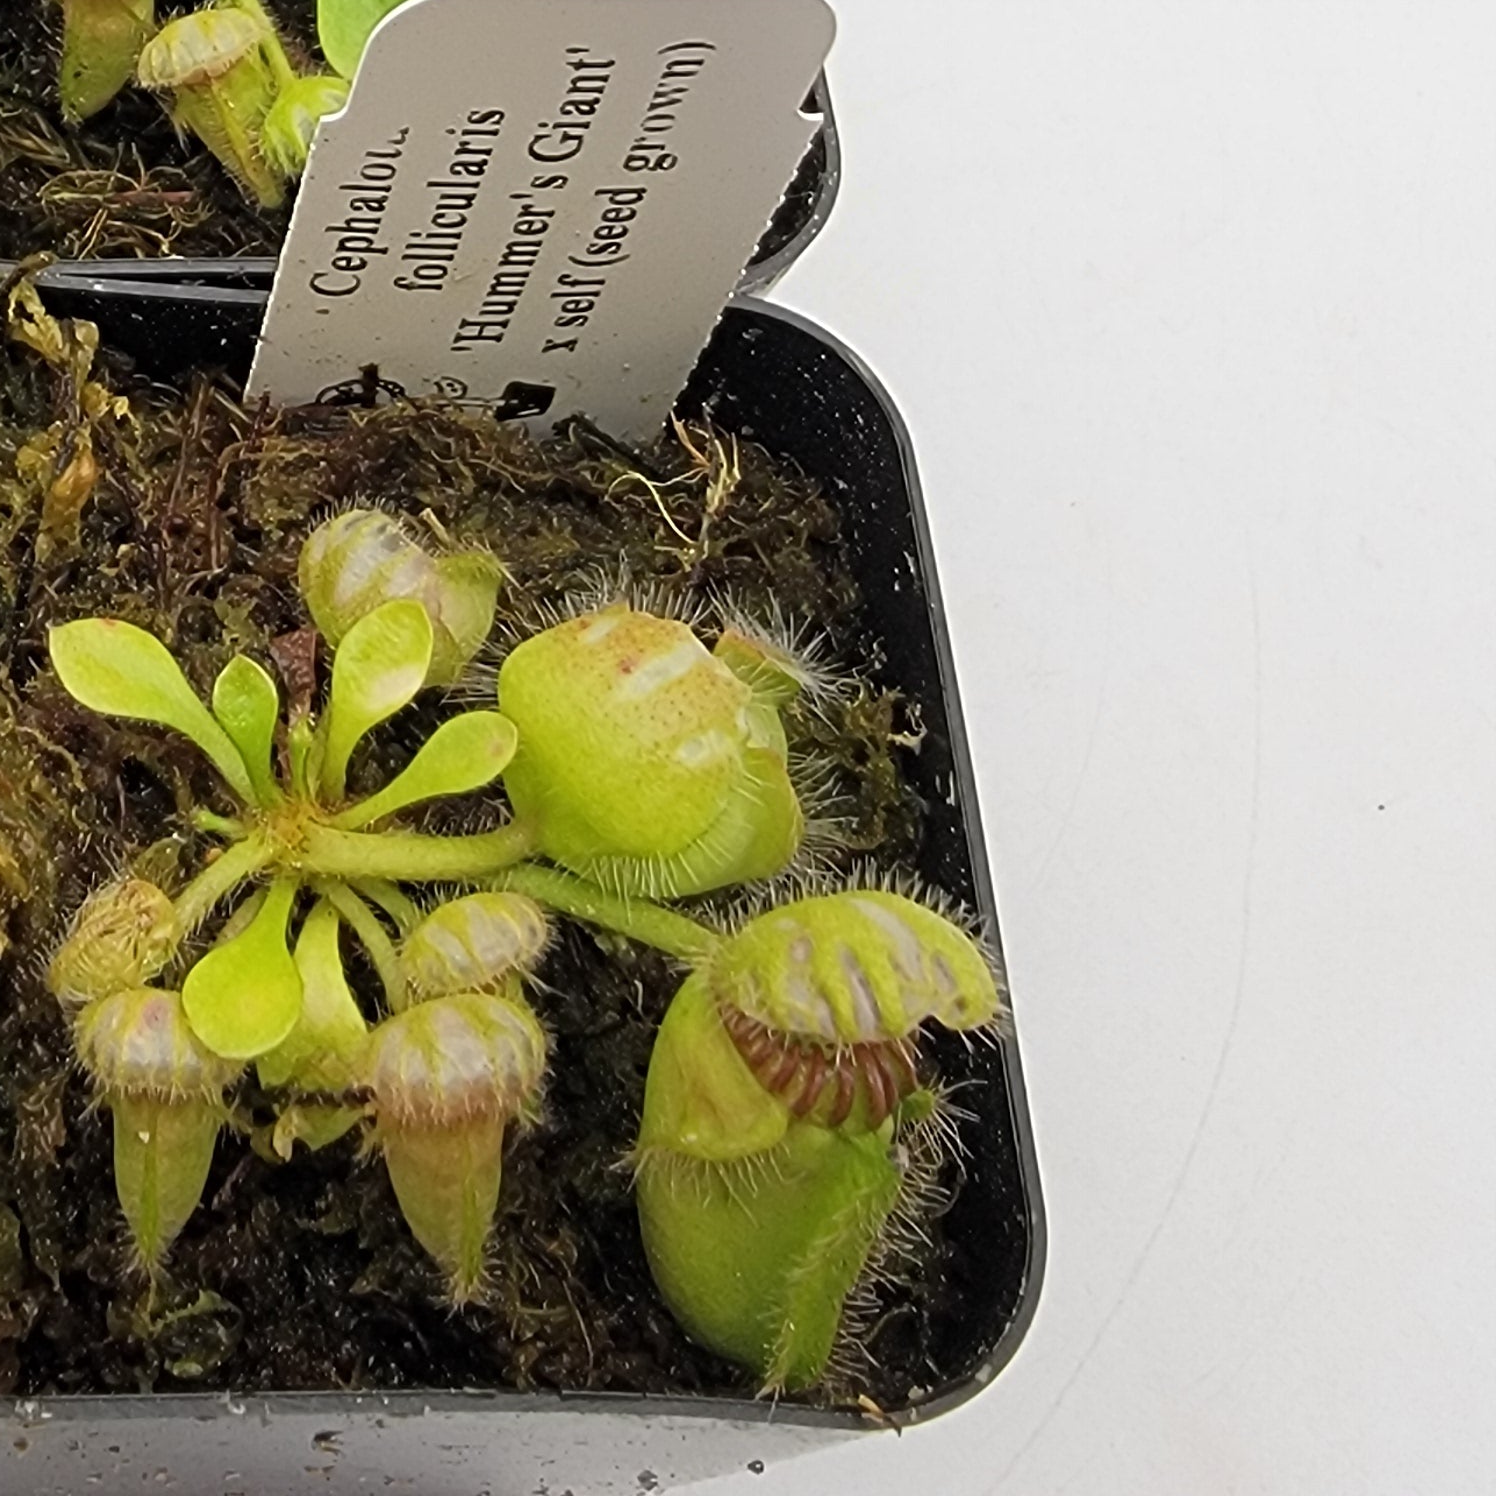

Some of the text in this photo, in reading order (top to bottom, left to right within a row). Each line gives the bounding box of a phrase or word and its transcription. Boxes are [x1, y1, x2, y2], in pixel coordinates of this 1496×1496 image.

[394, 108, 504, 291] follicularis
[450, 47, 616, 353] 'Hummer's Giant'
[542, 40, 717, 353] x self (seed grown)
